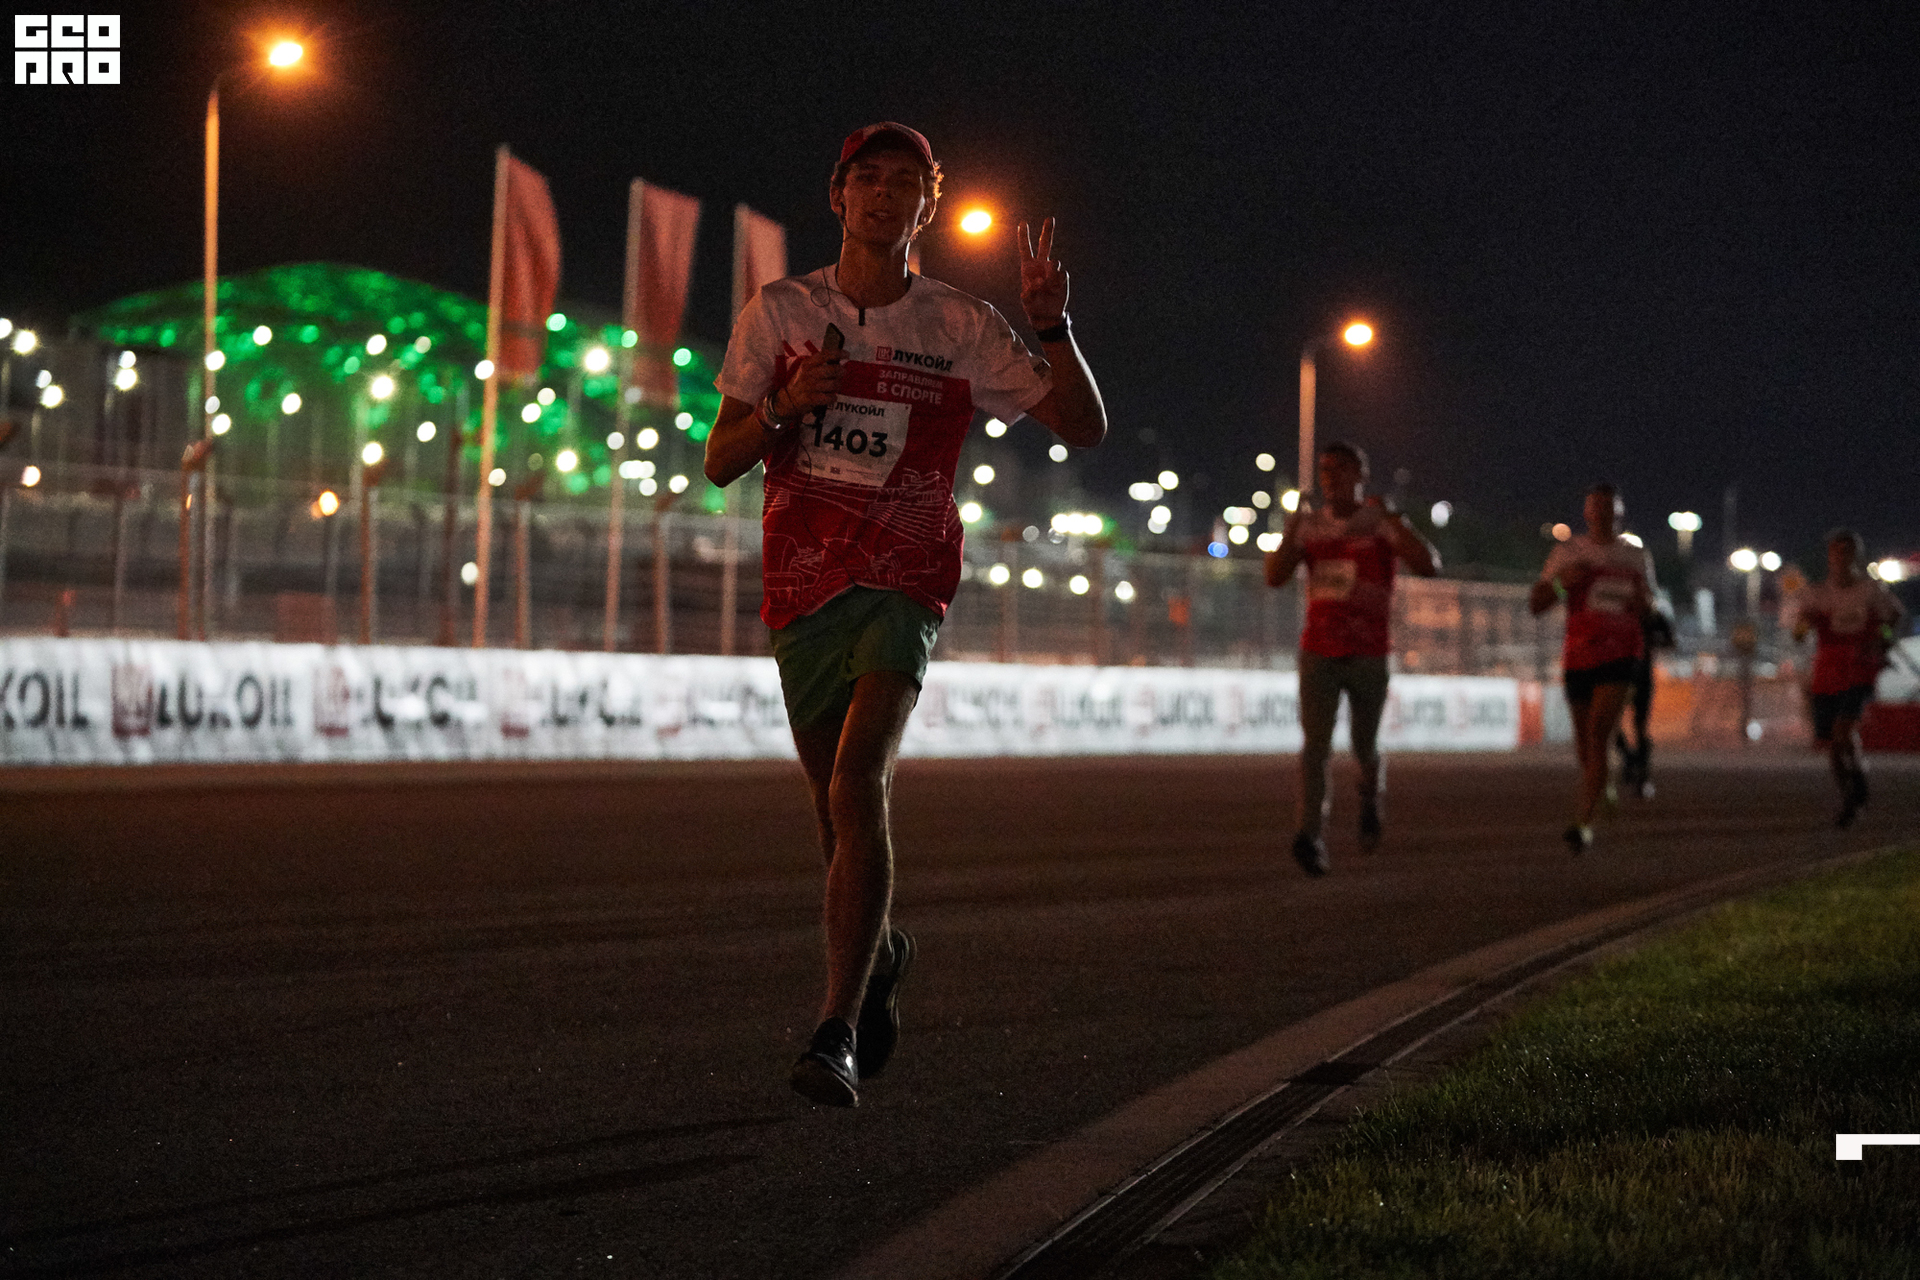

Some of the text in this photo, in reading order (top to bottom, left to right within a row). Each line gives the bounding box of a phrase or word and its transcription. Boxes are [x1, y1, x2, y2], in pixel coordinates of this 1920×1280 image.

[893, 349, 953, 372] ЛУКОЙЛ
[876, 381, 943, 405] В СПОРТЕ
[835, 401, 885, 417] ЛУКОЙЛ
[812, 422, 888, 457] 1403
